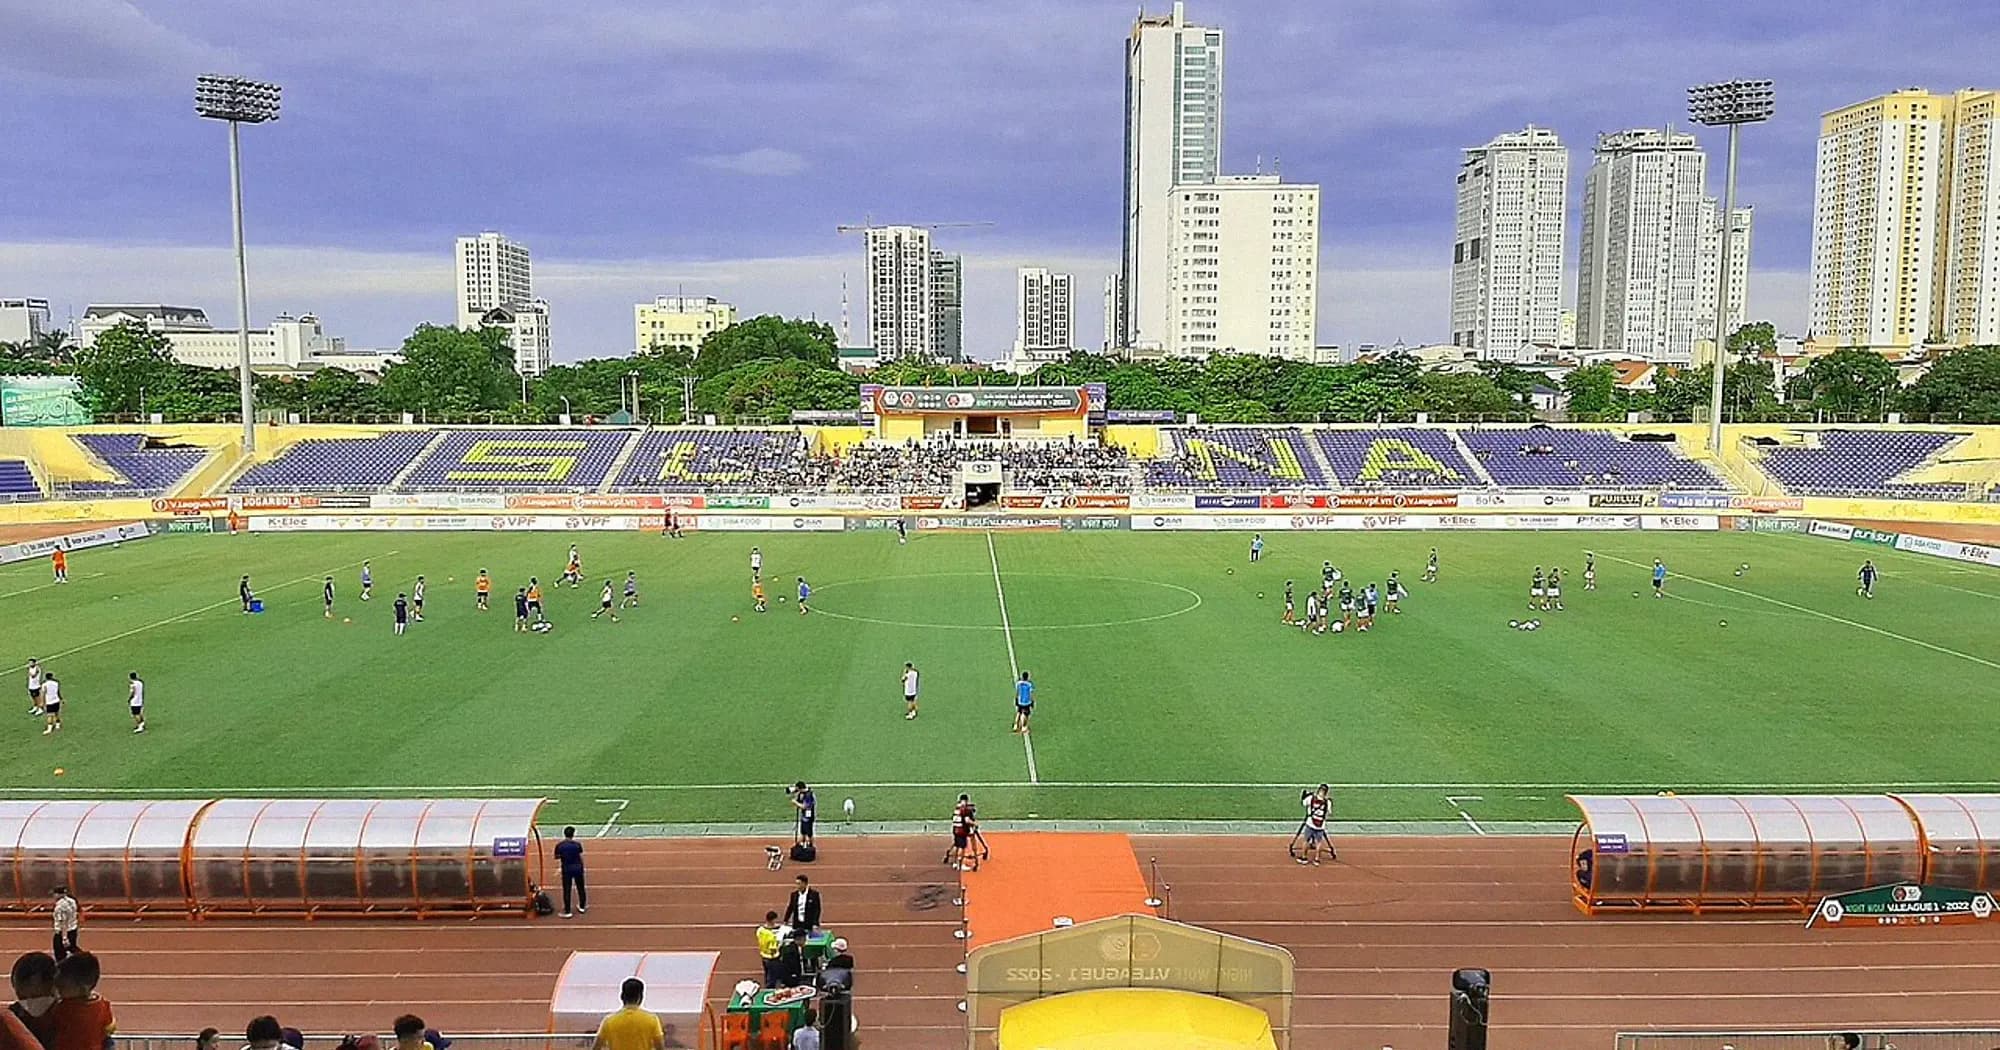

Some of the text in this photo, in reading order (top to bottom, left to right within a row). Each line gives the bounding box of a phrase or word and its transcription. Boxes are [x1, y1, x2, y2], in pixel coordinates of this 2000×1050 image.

[508, 517, 537, 526] VPF
[582, 517, 611, 526] VPF
[1306, 516, 1335, 525] VPF
[1378, 516, 1407, 525] VPF
[1946, 902, 1969, 910] 2022
